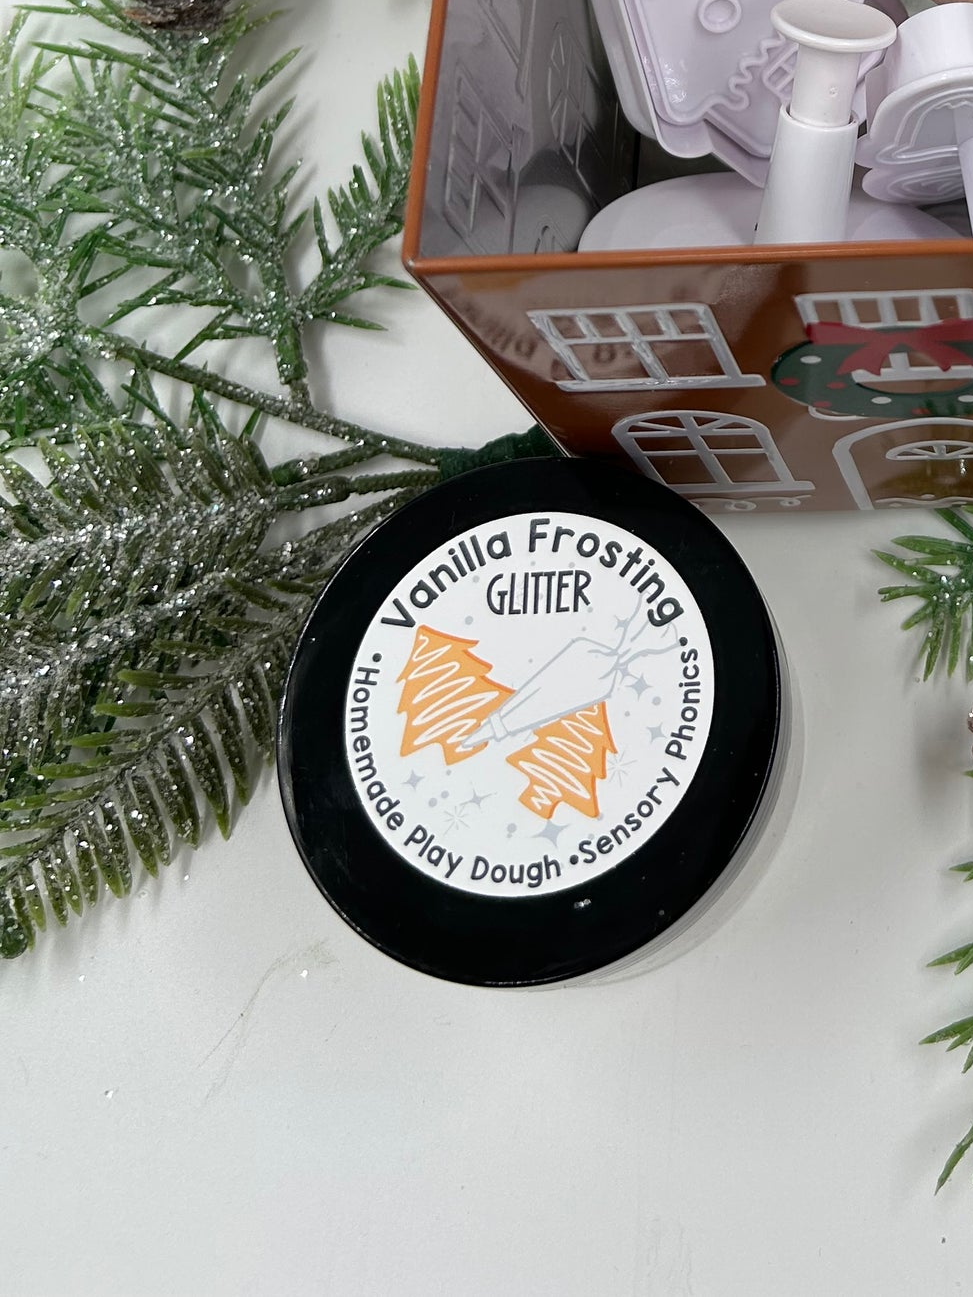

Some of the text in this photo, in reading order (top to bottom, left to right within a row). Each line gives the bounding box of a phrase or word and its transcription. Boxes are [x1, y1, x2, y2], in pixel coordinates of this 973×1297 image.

[381, 518, 684, 628] Vanilla Frosting
[486, 570, 592, 615] GLITTER
[350, 667, 561, 888] Homemade Play Dough
[578, 648, 701, 864] Sensory Phonics
